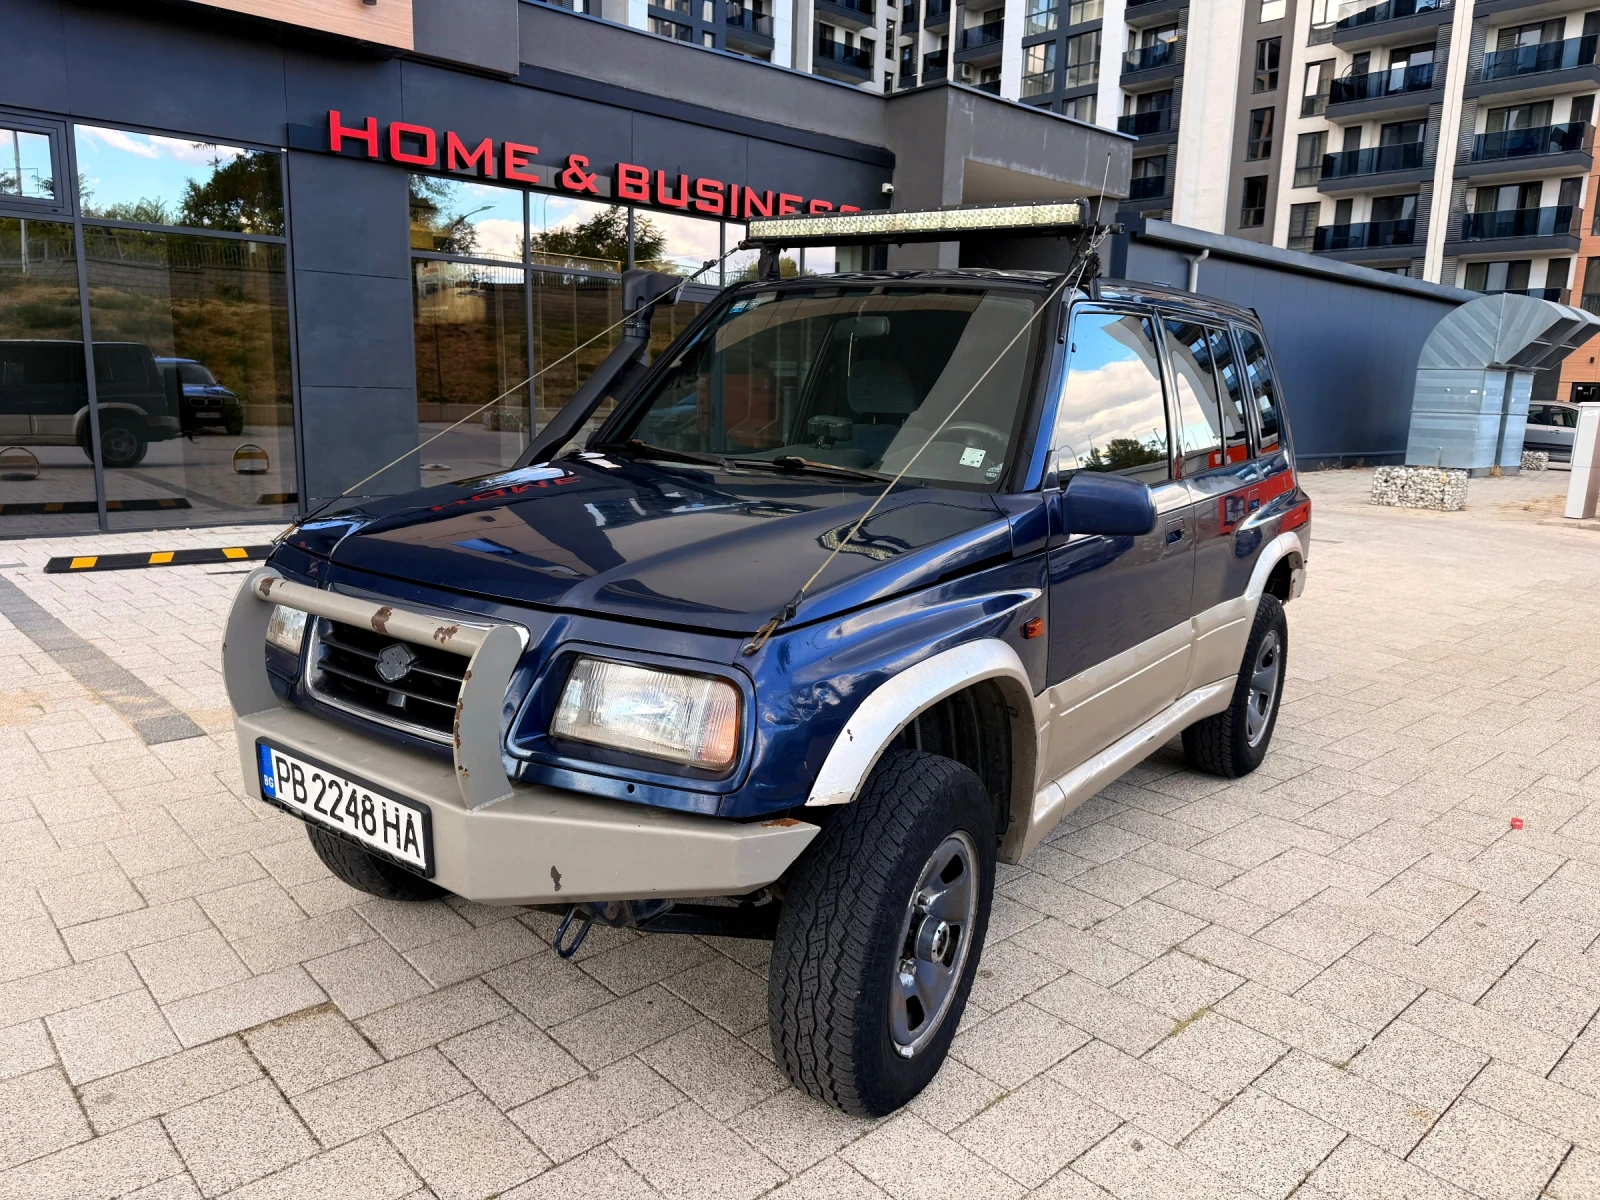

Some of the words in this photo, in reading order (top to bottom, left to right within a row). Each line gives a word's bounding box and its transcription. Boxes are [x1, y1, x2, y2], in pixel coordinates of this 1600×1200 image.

[329, 109, 539, 184] HOME
[561, 154, 598, 193] &
[264, 775, 274, 788] BG
[275, 756, 307, 804] PB
[312, 774, 376, 836] 2248
[382, 802, 420, 859] HA
